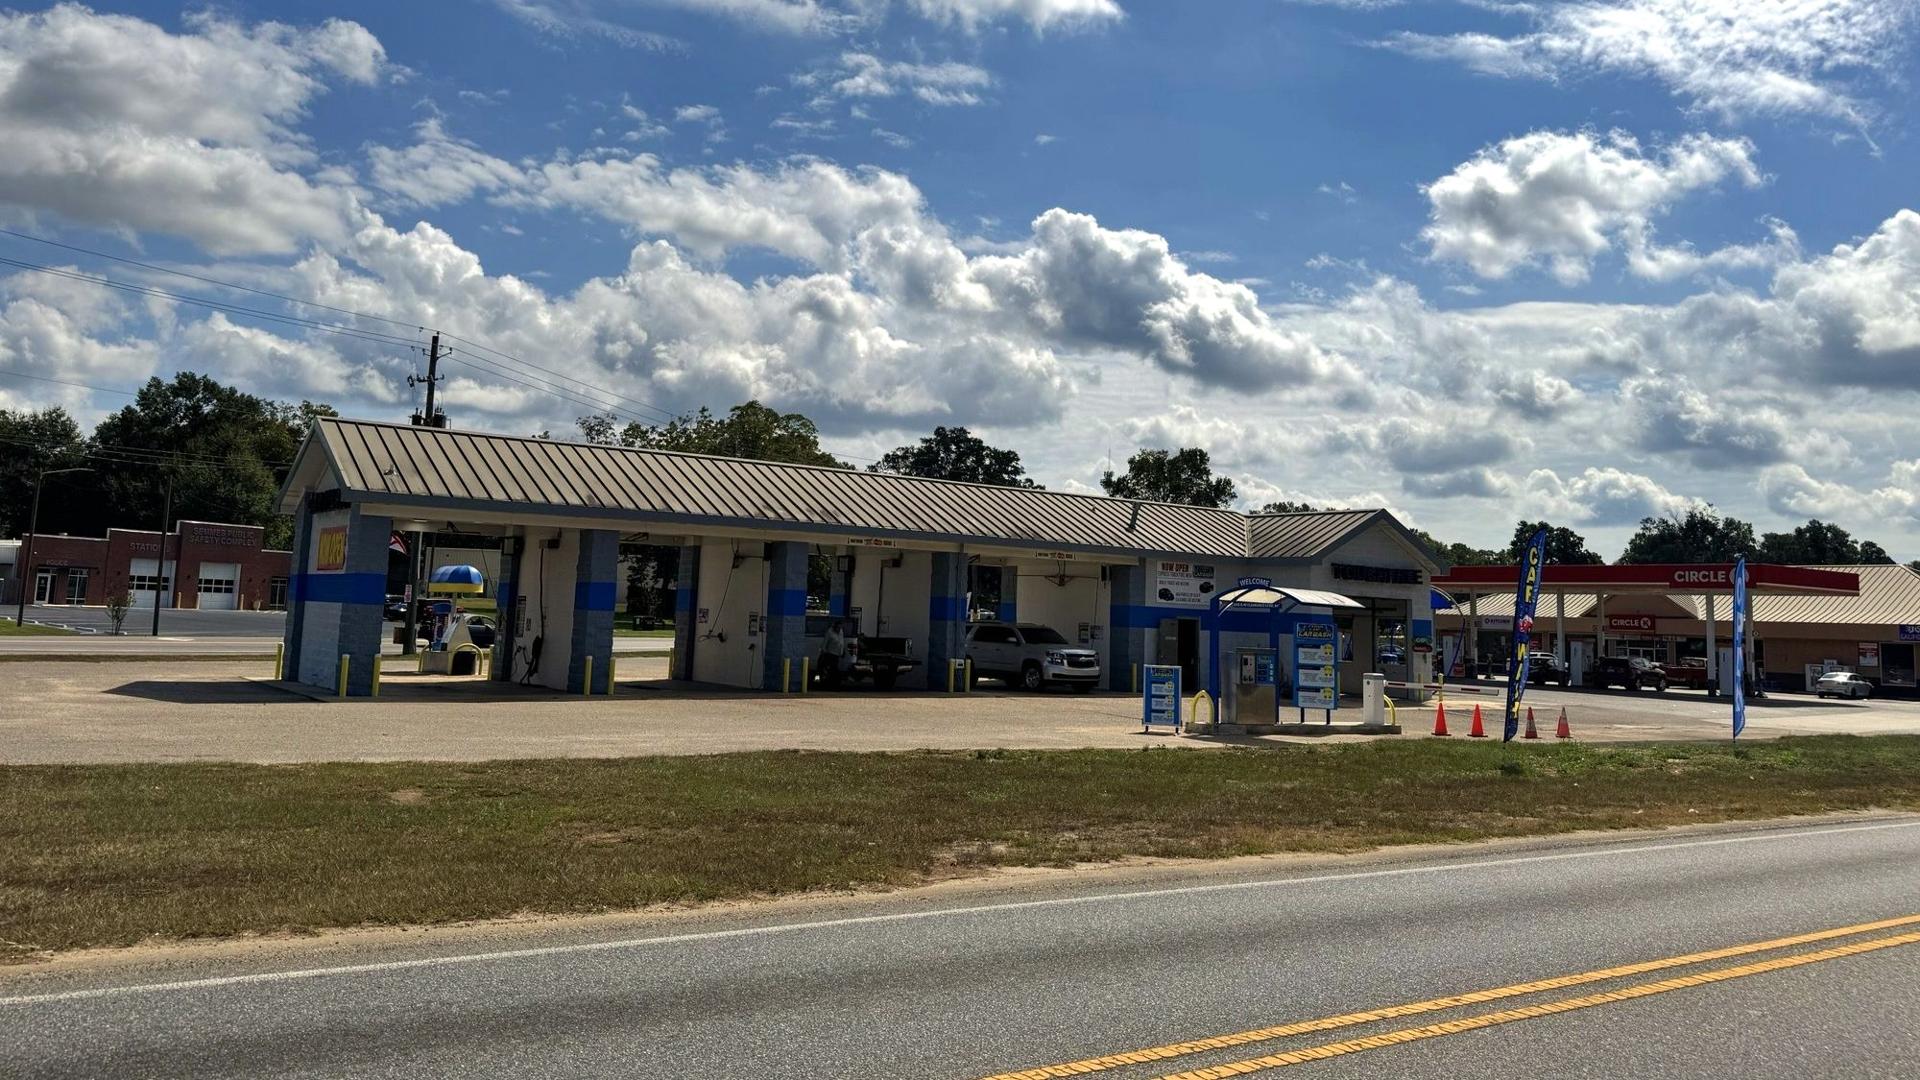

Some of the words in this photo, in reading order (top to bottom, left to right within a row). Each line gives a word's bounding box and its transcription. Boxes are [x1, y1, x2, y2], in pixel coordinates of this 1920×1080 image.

[1674, 570, 1726, 583] CIRCLE
[1239, 577, 1271, 587] WELCOME
[1611, 618, 1640, 627] CIRCLE
